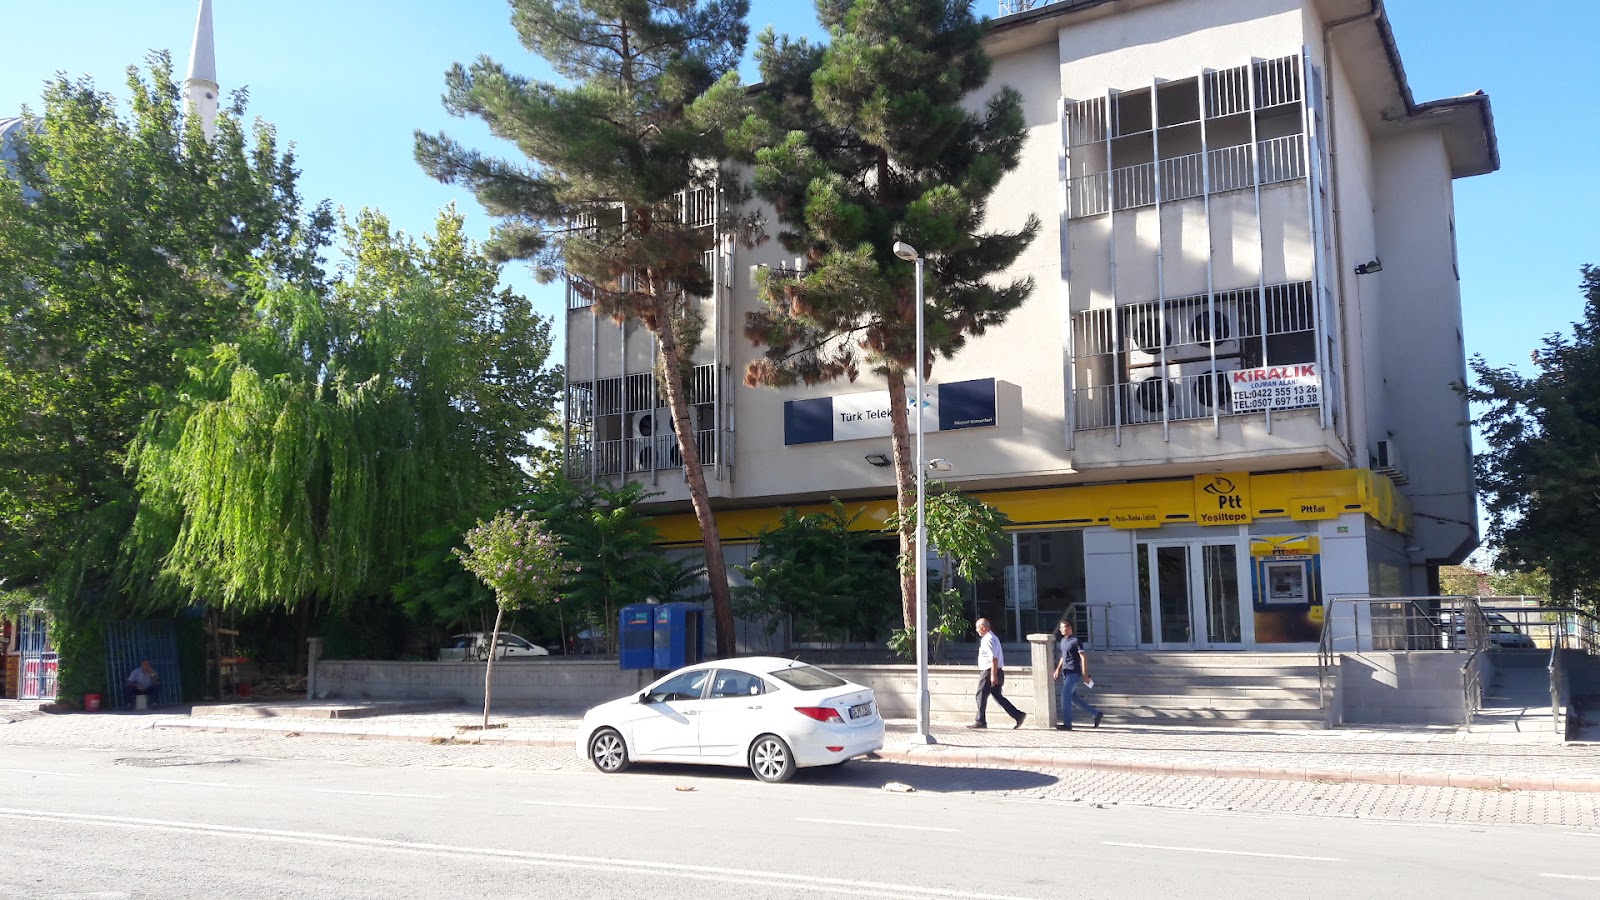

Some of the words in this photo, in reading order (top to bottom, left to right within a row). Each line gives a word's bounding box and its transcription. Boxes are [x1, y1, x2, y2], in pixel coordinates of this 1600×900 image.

[1251, 380, 1276, 388] LOJMAN
[1234, 388, 1272, 400] TEL:0422
[1275, 388, 1291, 396] 555
[1294, 386, 1304, 394] 13
[1307, 385, 1317, 393] 26
[1234, 398, 1272, 409] TEL:0507
[1276, 397, 1291, 406] 697
[1307, 394, 1317, 403] 38
[840, 412, 862, 422] Türk
[1219, 495, 1242, 509] Ptt
